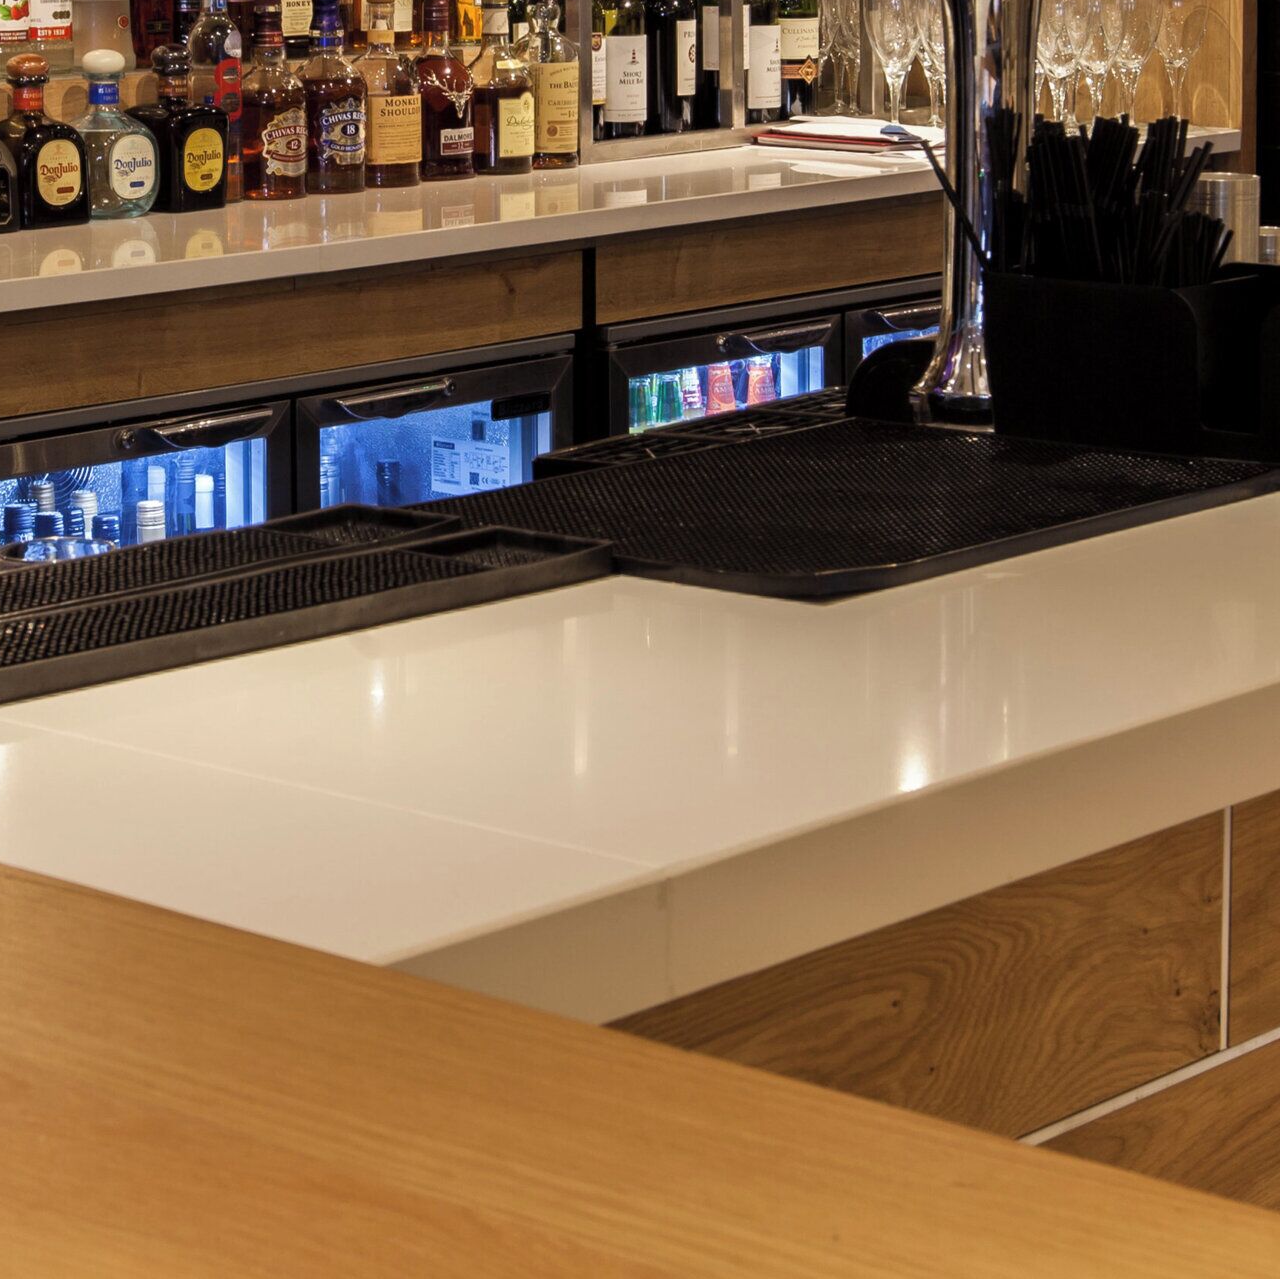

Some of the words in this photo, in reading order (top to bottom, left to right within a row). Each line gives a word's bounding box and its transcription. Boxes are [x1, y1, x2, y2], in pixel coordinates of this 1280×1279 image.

[286, 0, 311, 8] HONEY
[322, 113, 352, 126] CHIVAS
[265, 127, 295, 141] CHIVAS
[346, 125, 355, 134] 18
